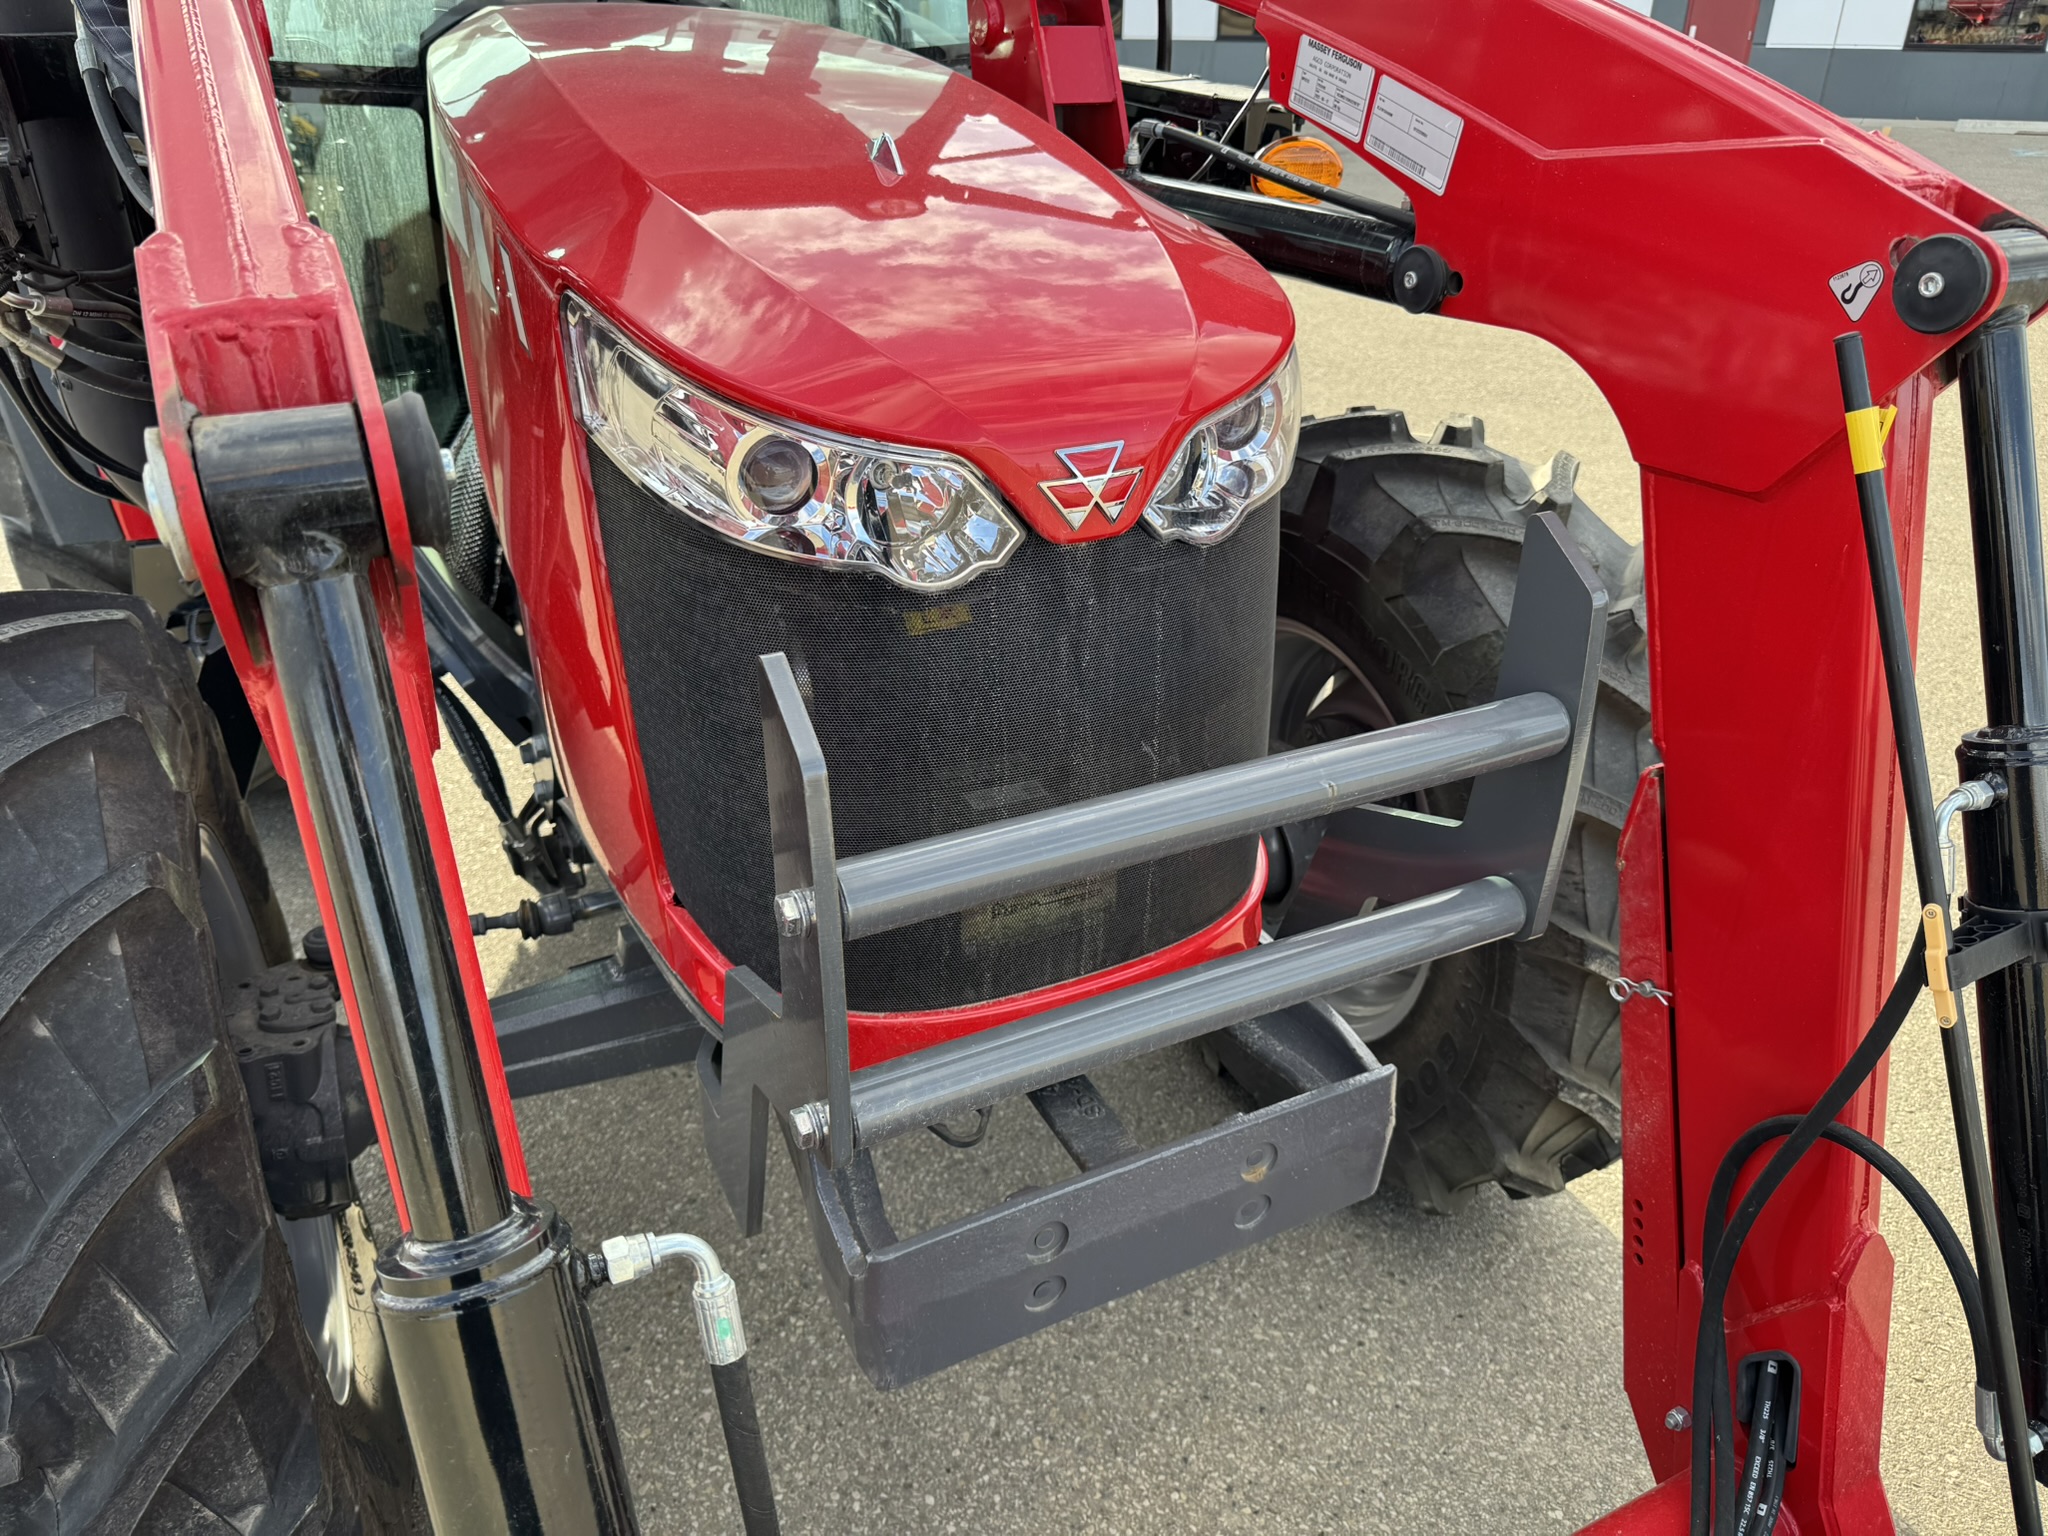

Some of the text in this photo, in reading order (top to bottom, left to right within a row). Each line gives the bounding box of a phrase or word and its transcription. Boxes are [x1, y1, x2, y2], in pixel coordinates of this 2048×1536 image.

[1308, 39, 1363, 71] MASSEY FERGUSON
[1324, 61, 1352, 79] CORPORATION
[1752, 1456, 1761, 1478] EXCEED
[1749, 1481, 1757, 1491] EN
[1746, 1490, 1754, 1503] 857
